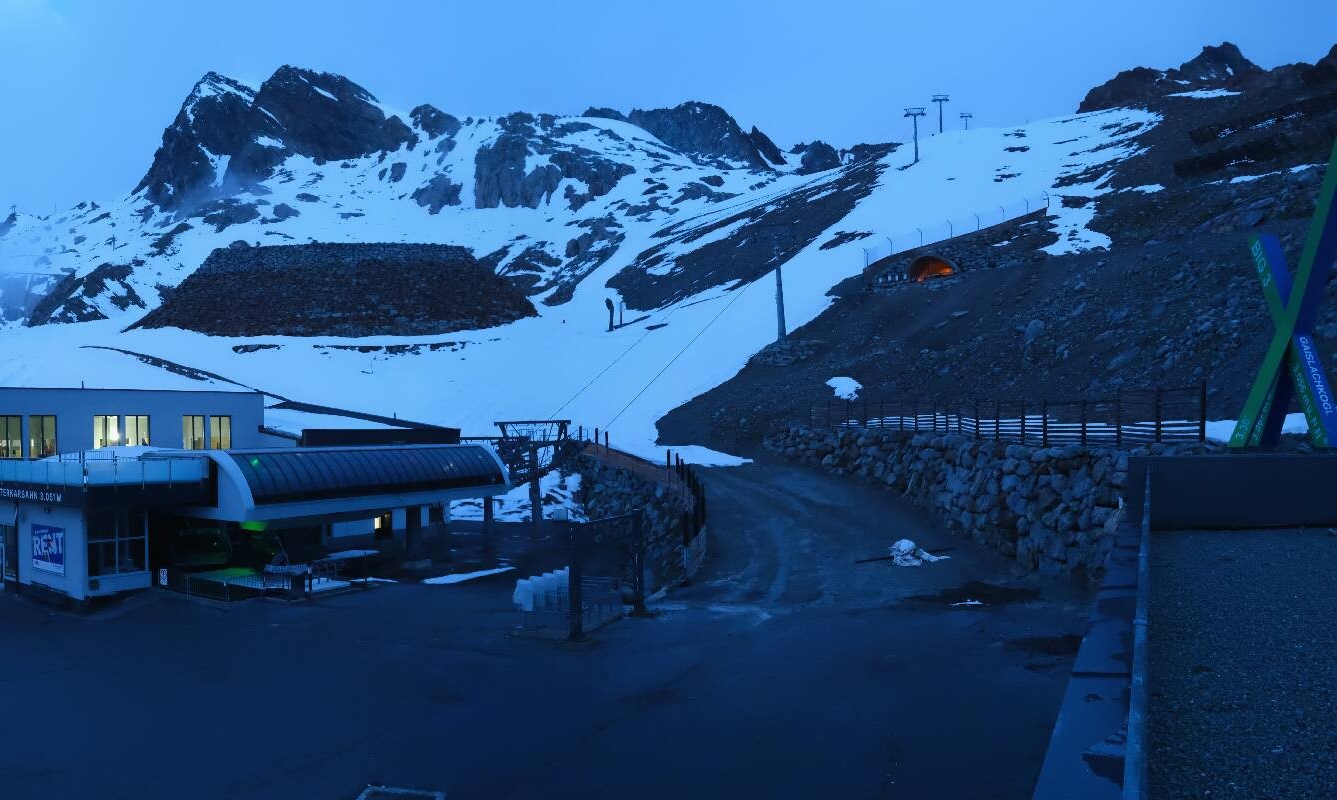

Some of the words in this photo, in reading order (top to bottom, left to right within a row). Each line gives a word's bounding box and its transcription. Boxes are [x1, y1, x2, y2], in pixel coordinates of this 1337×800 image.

[1252, 240, 1267, 272] BIG
[1263, 272, 1272, 288] 3
[1300, 336, 1334, 416] GAISLACHKOGL
